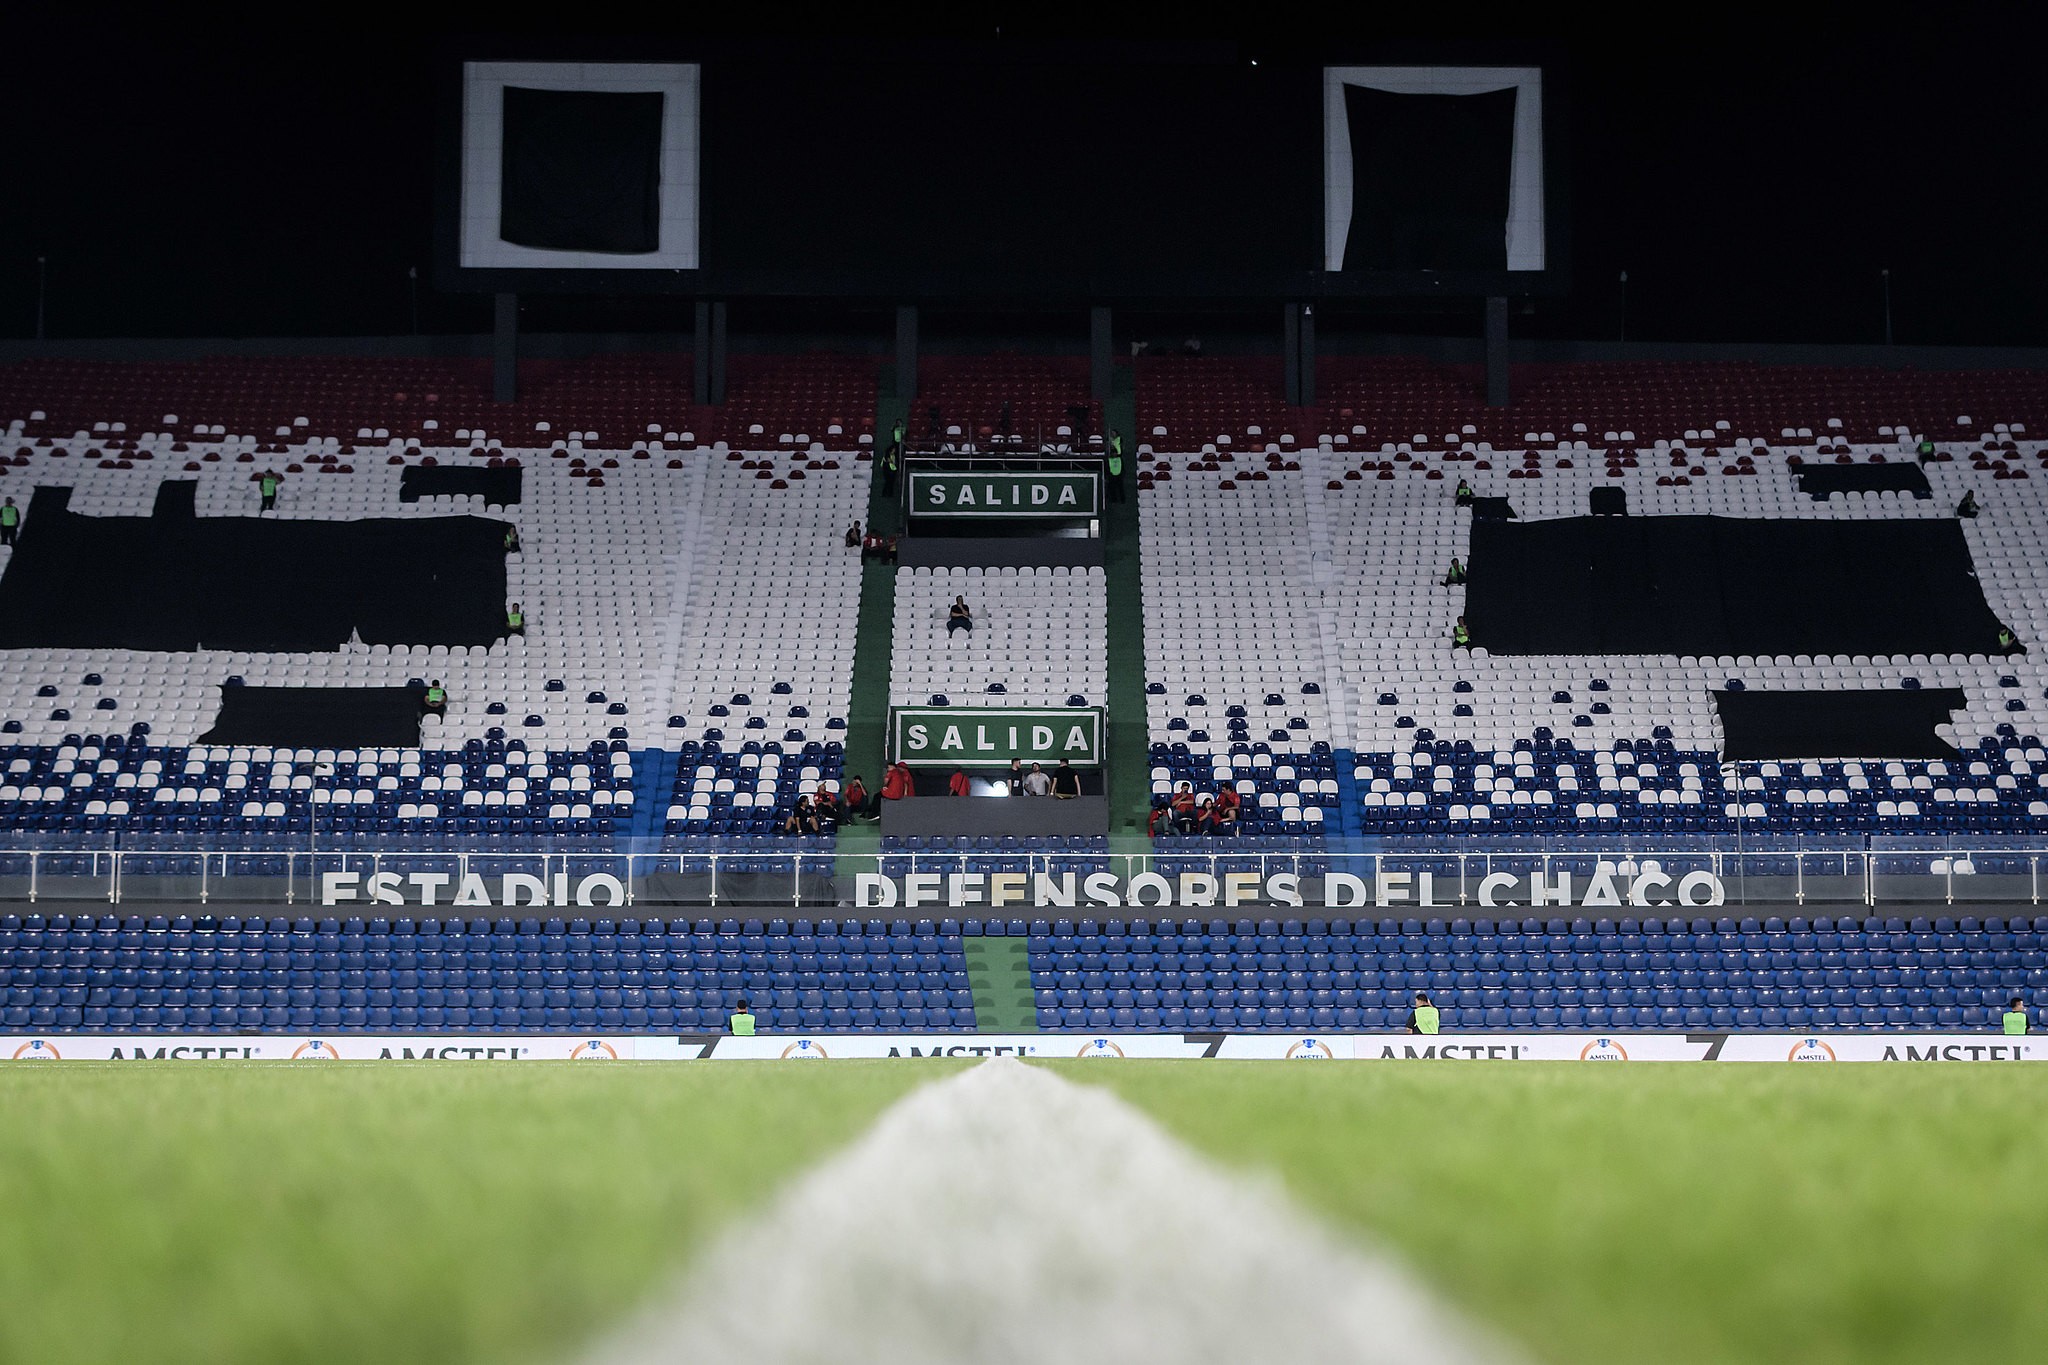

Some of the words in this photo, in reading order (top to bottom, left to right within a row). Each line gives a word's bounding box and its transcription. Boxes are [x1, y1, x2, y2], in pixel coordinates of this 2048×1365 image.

[929, 484, 1077, 505] SALIDA
[907, 724, 1089, 751] SALIDA
[322, 872, 625, 906] ESTADIO
[855, 871, 1304, 907] DEFENSORES
[1324, 872, 1453, 907] DEL
[1478, 870, 1725, 907] CHACO
